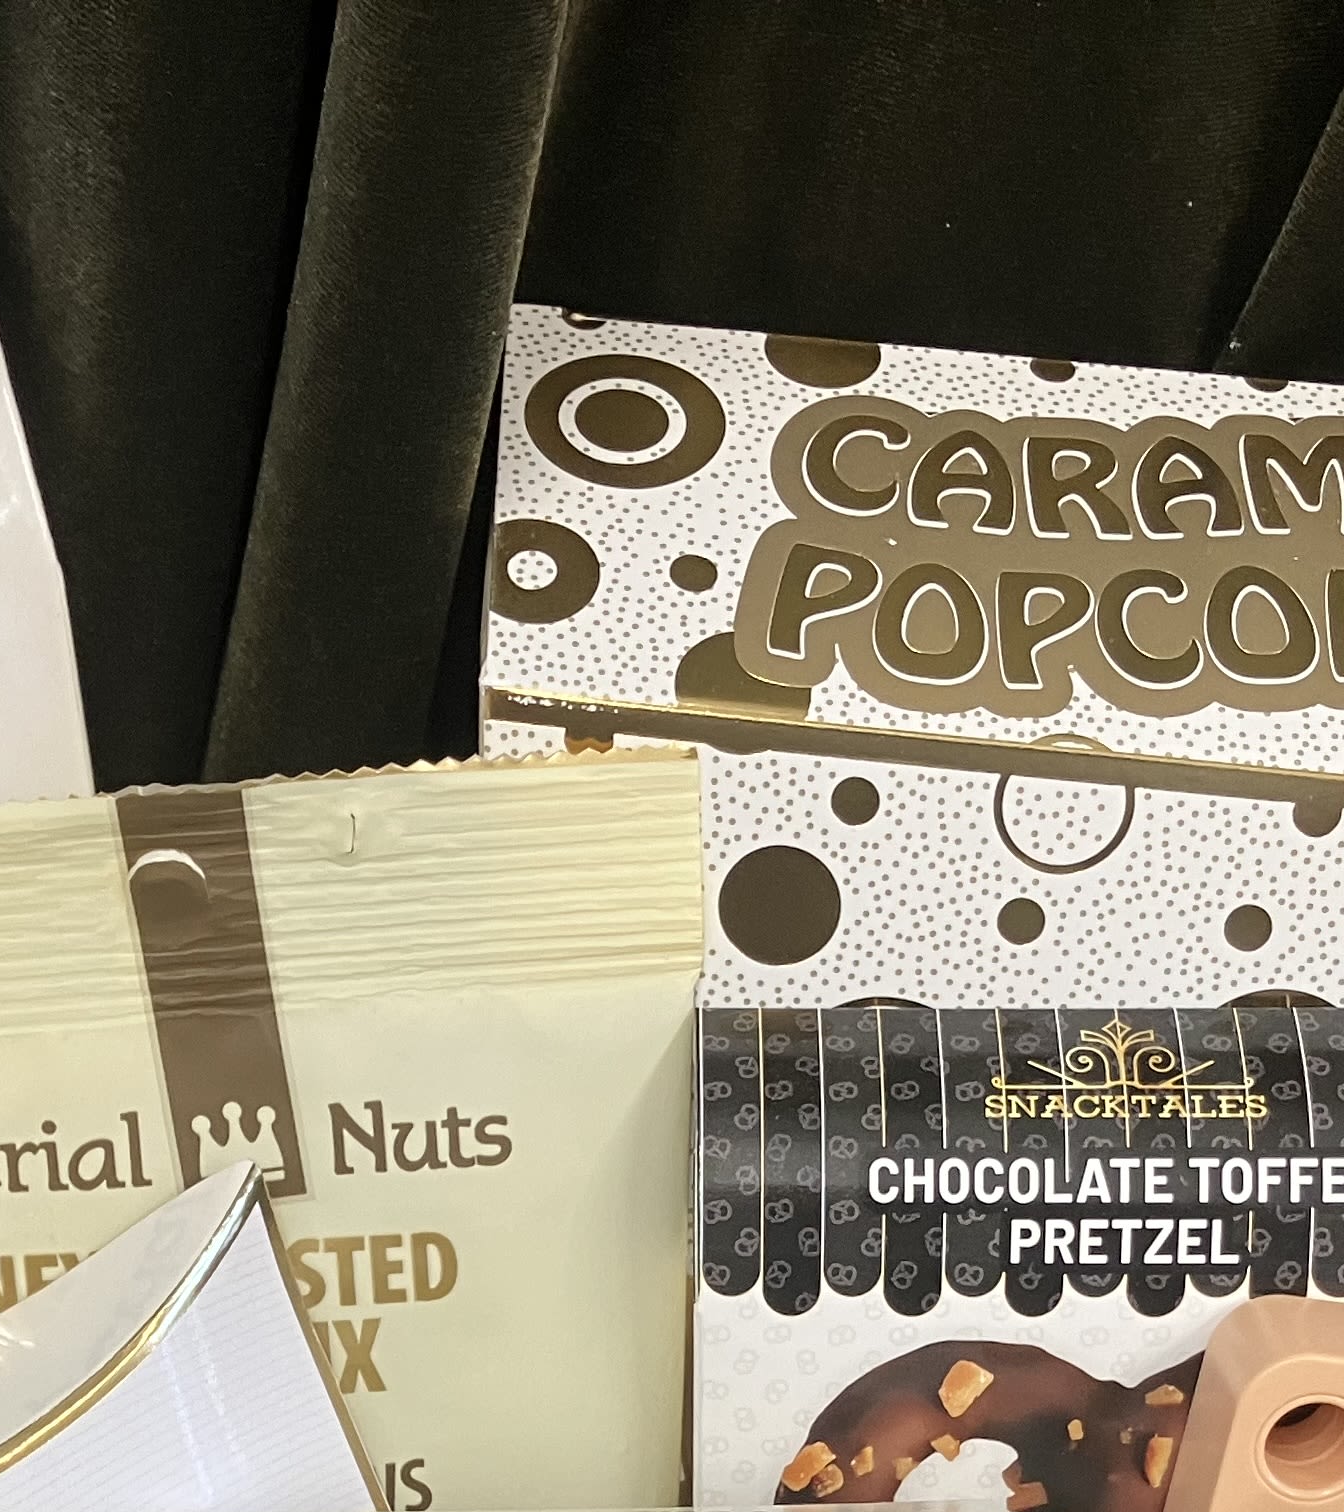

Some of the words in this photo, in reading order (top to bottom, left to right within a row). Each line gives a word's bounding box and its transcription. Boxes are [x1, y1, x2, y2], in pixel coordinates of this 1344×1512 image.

[984, 1094, 1268, 1119] SNACKTALES
[328, 1099, 514, 1175] Nuts
[867, 1155, 1174, 1205] CHOCOLATE
[1008, 1217, 1240, 1266] PRETZEL
[285, 1231, 459, 1309] STED
